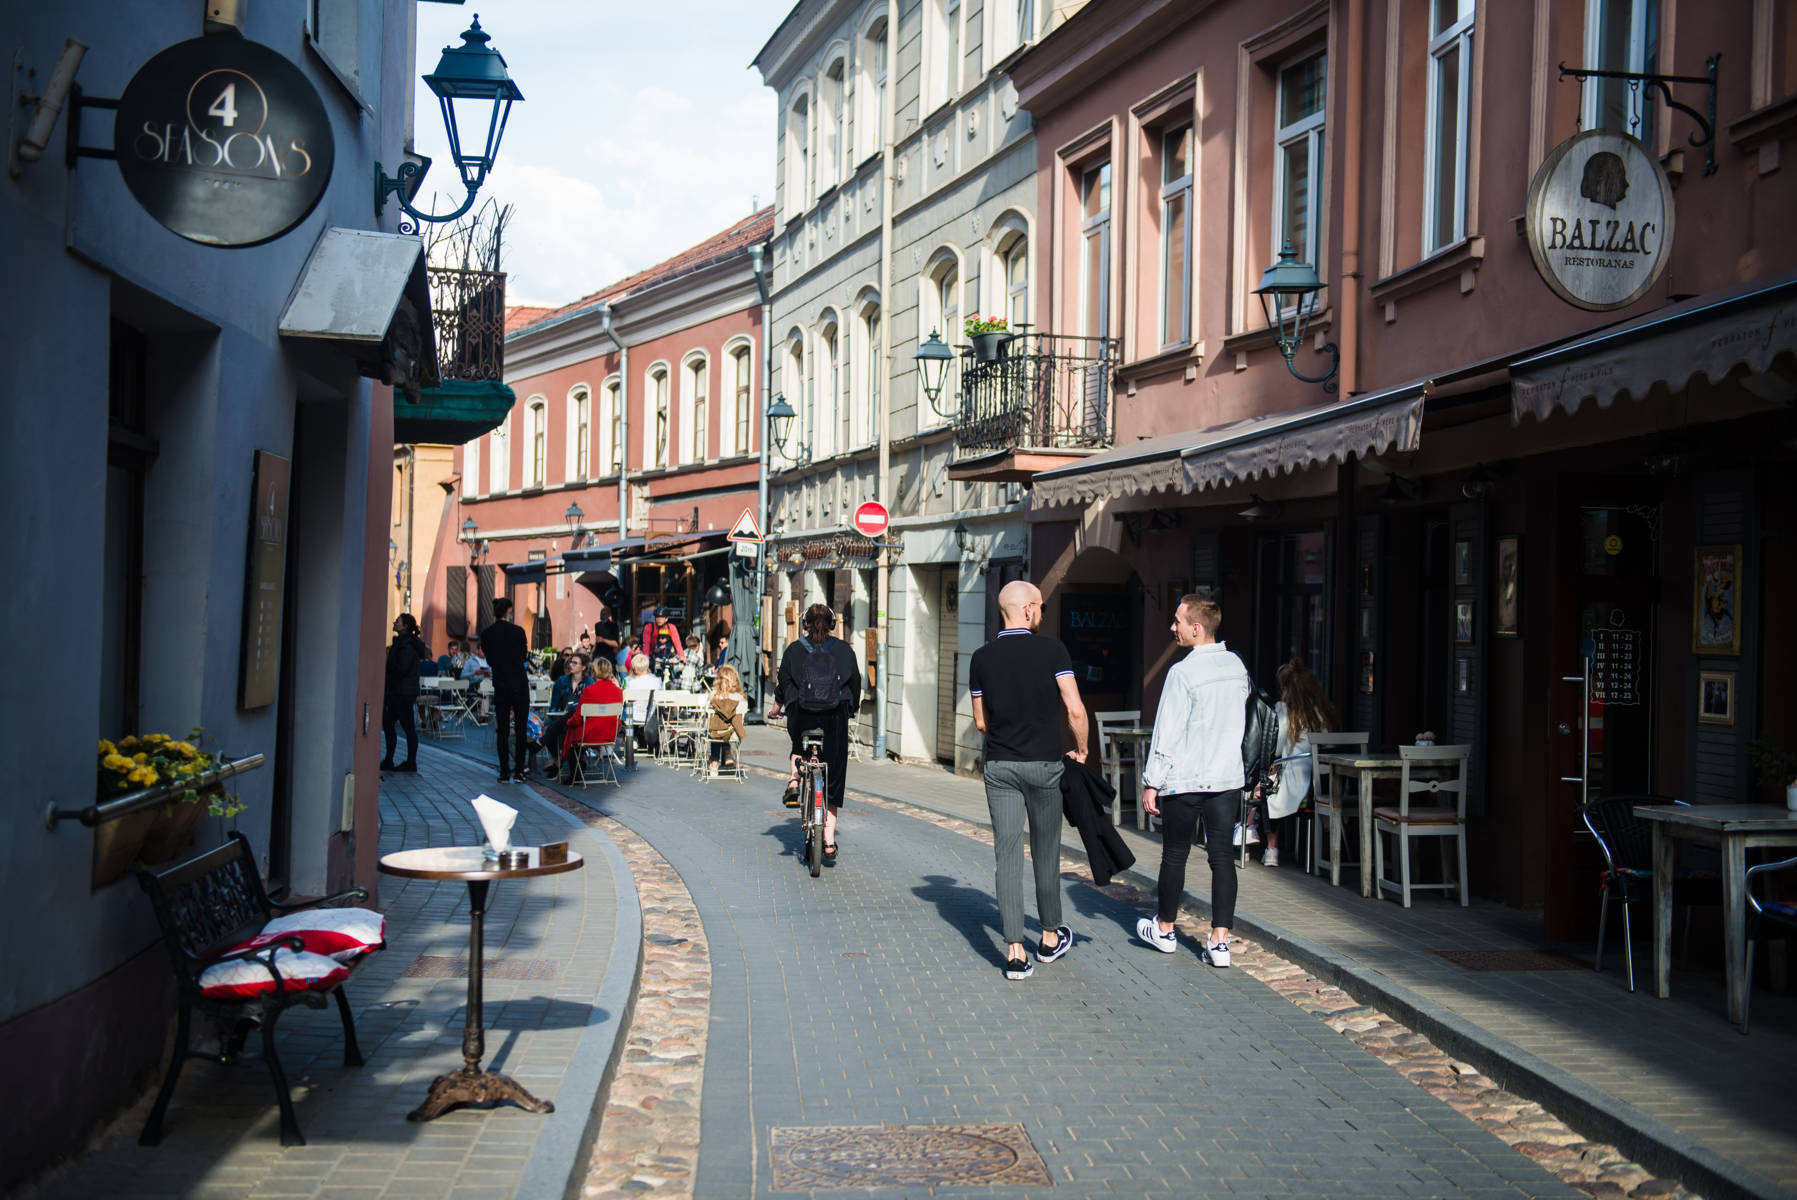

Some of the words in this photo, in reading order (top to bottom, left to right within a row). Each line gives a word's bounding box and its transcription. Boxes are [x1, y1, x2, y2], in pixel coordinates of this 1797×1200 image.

[208, 82, 238, 127] 4
[1549, 217, 1656, 255] BALZAC
[1564, 255, 1635, 269] RESTORANAS
